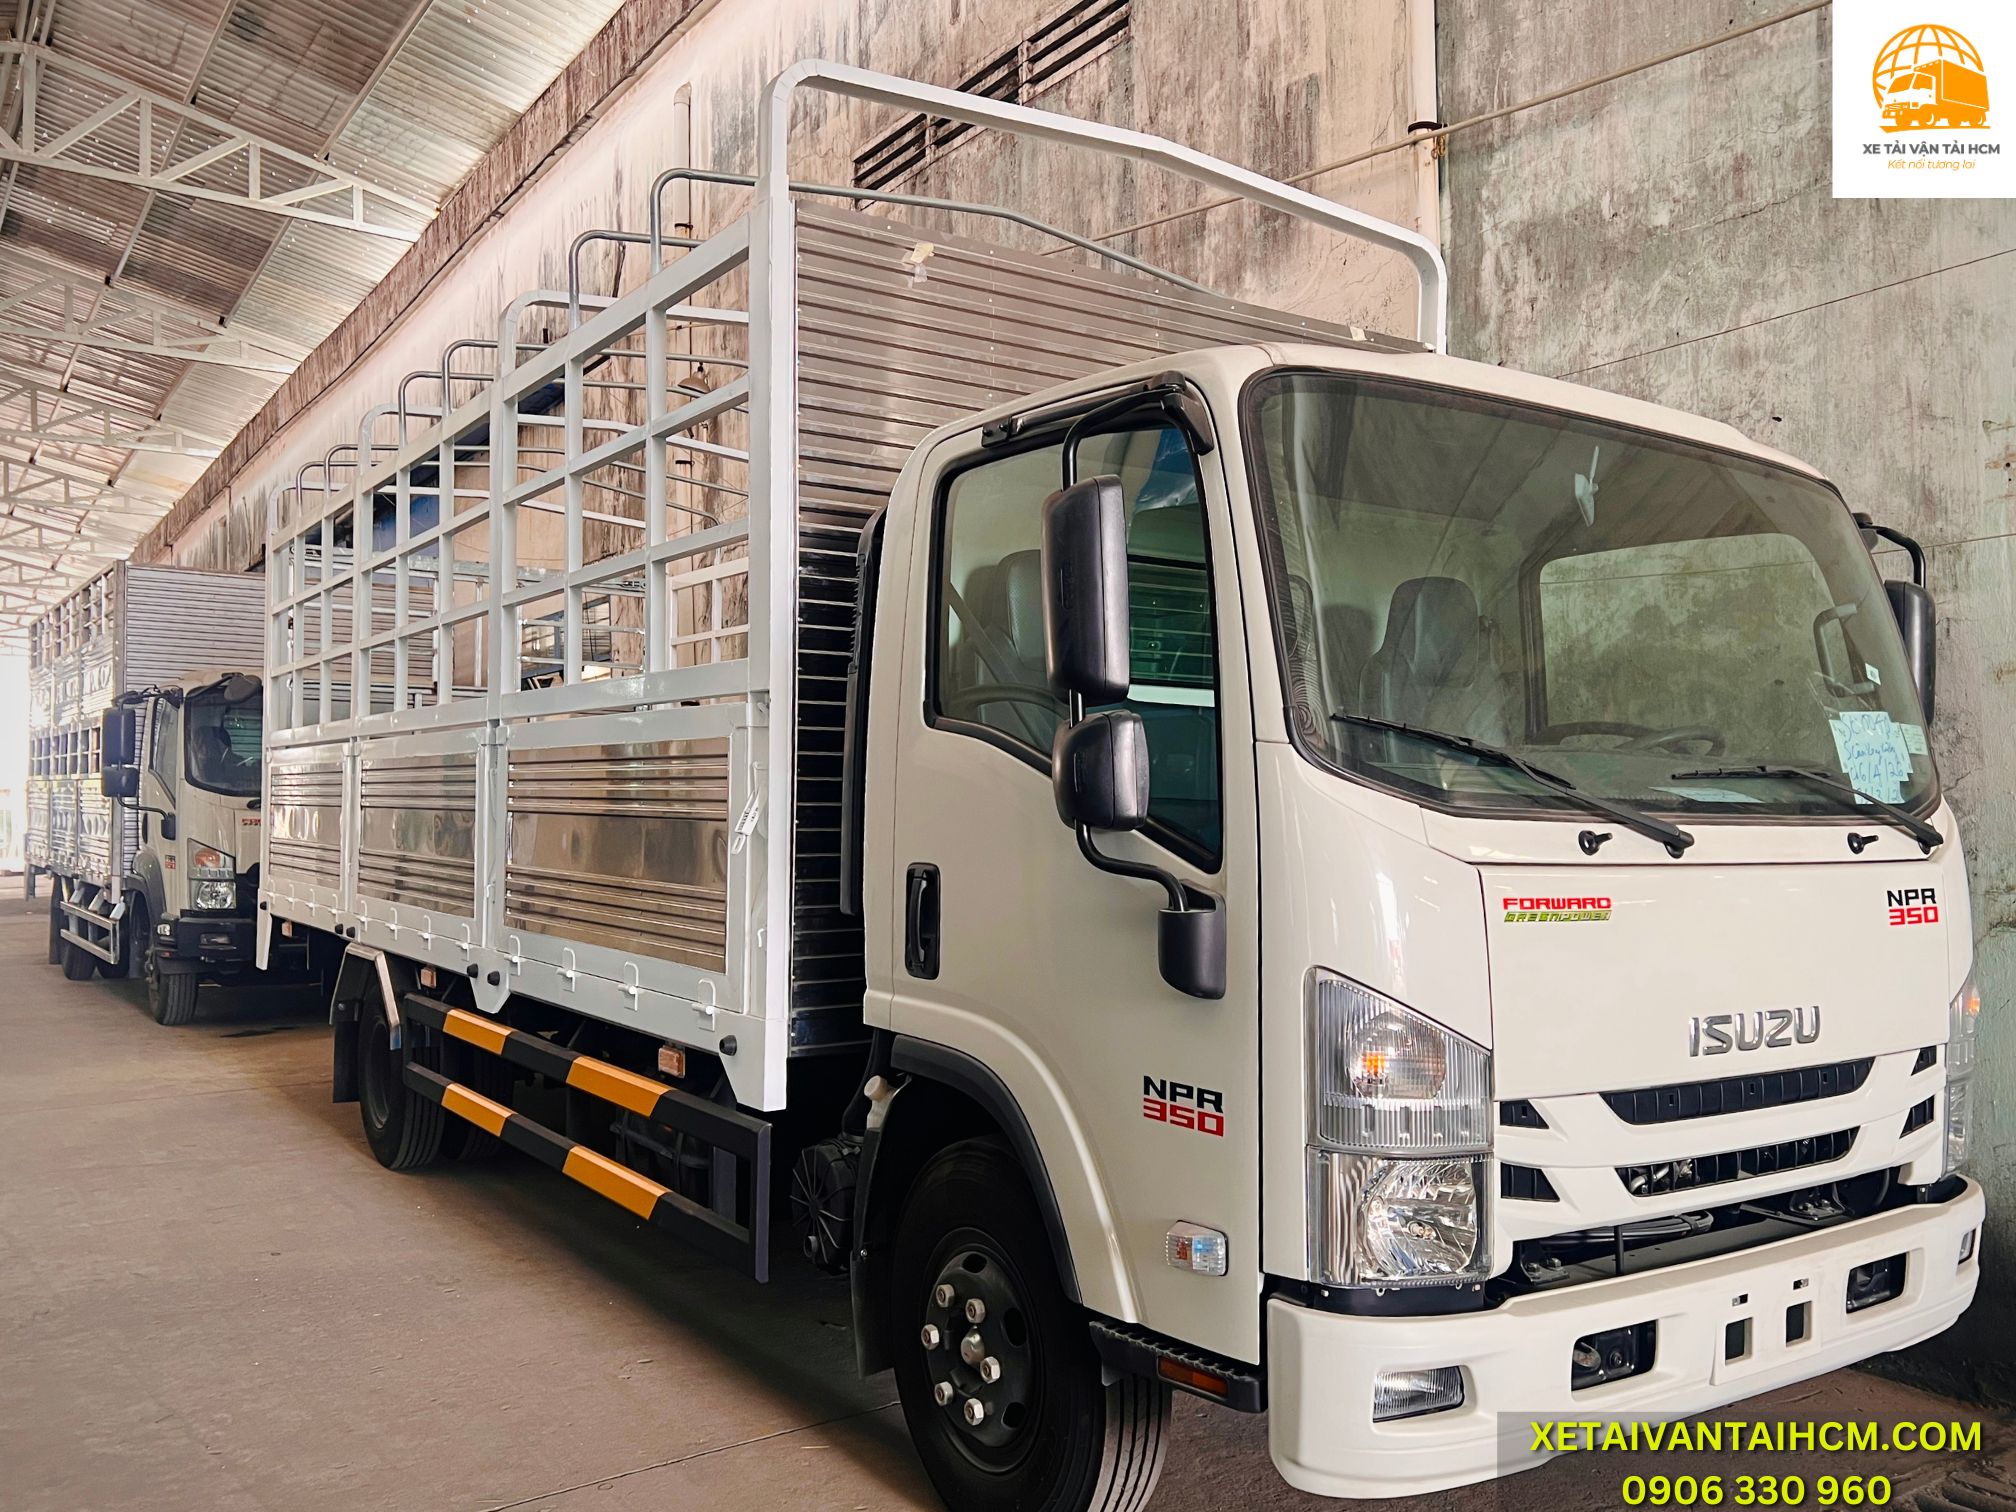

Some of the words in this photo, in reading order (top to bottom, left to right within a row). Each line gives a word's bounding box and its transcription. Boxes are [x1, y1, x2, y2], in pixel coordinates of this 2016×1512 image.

[1502, 897, 1613, 910] FORWARD
[1886, 888, 1937, 907] NPR
[1889, 906, 1939, 926] 350
[1688, 1005, 1821, 1057] ISUZU
[1143, 1075, 1224, 1114] NPR
[1143, 1097, 1224, 1137] 350
